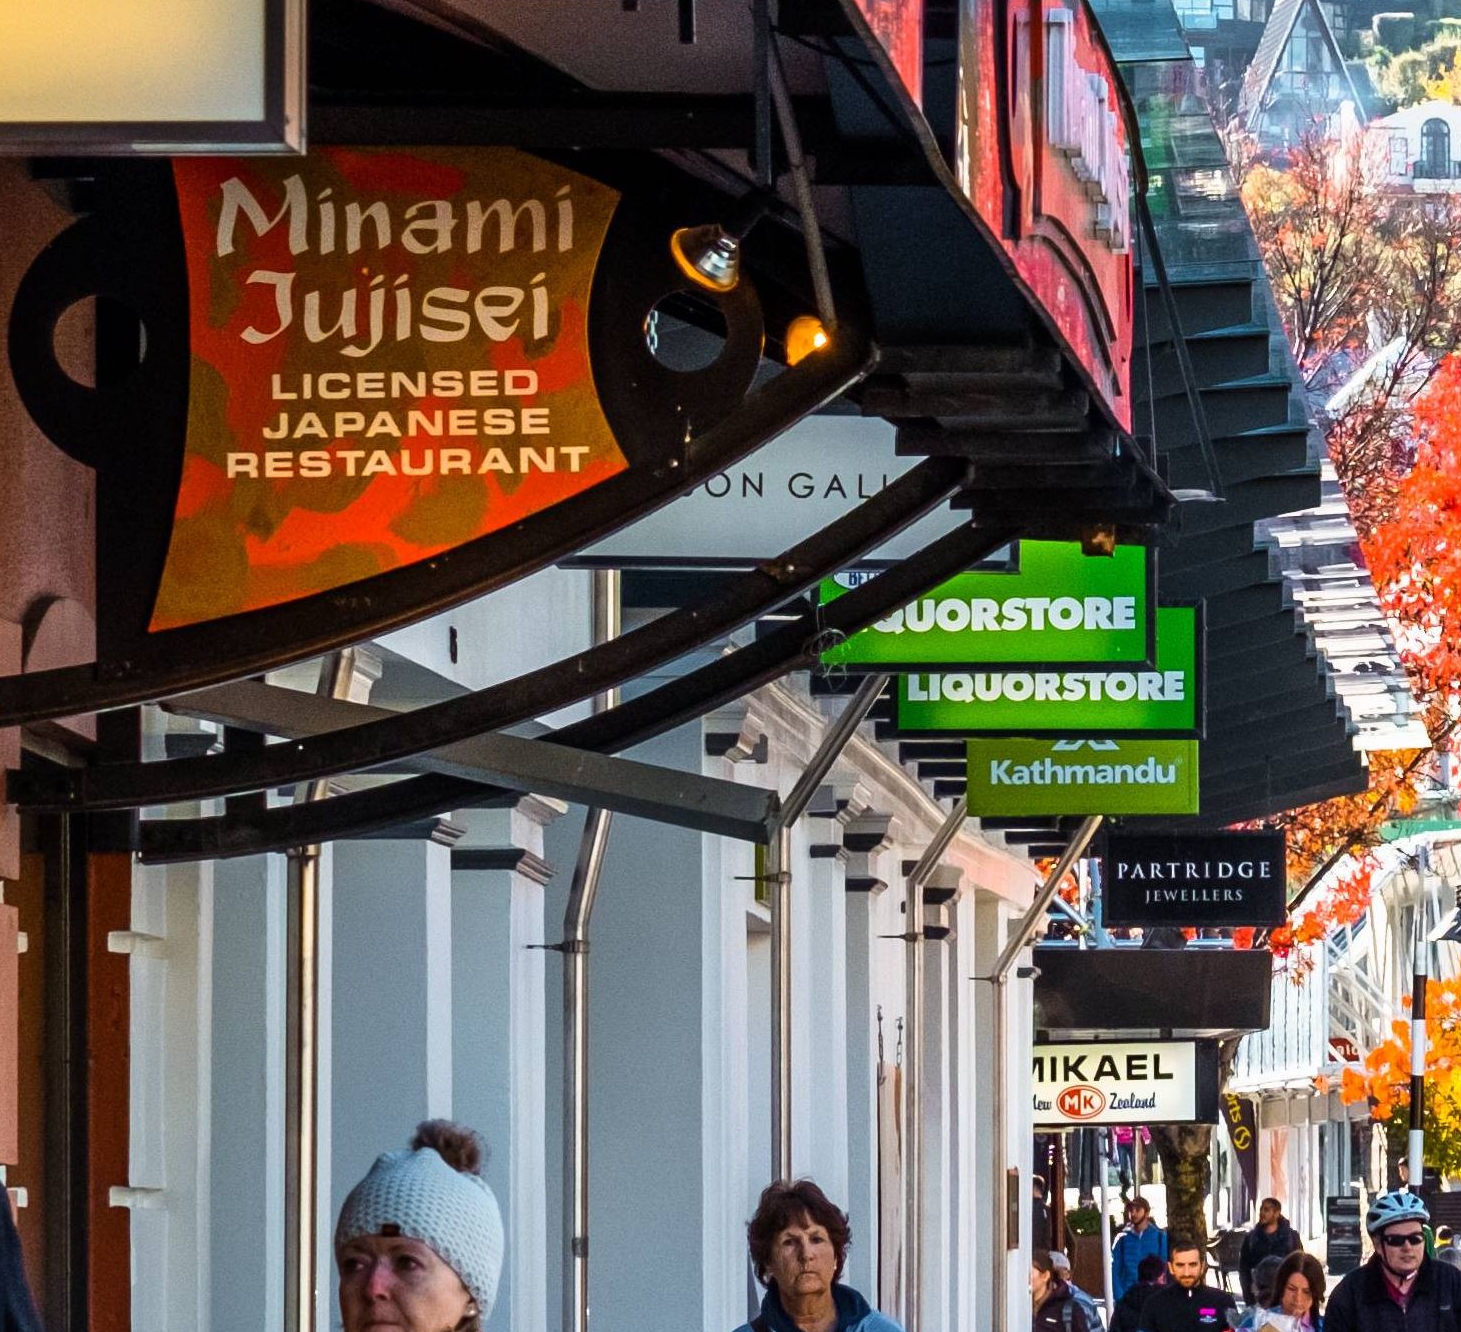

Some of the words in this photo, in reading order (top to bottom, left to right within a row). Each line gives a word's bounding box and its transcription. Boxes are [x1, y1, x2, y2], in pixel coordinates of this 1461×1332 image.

[217, 173, 574, 258] Minami
[240, 270, 549, 358] Jujisei
[271, 368, 539, 400] LICENSED
[262, 407, 551, 440] JAPANESE
[226, 445, 591, 479] RESTAURANT
[907, 670, 1185, 704] LIQUORSTORE
[989, 757, 1177, 786] Kathmandu
[1117, 860, 1272, 880] PARTRIDGE
[1145, 889, 1244, 904] JEWELLERS
[1109, 1092, 1157, 1110] Zealand
